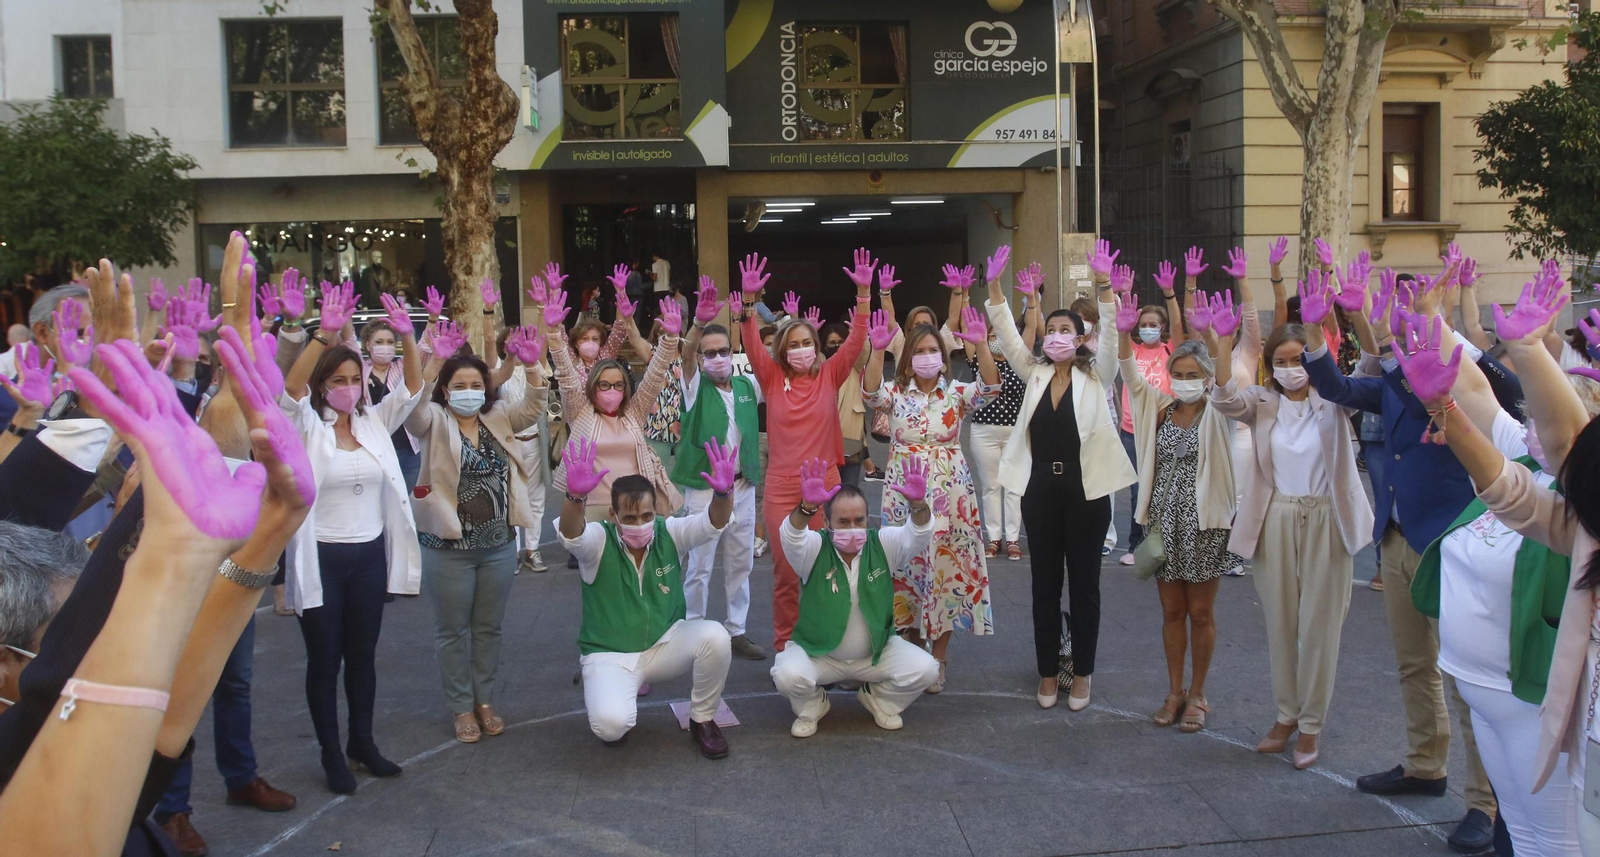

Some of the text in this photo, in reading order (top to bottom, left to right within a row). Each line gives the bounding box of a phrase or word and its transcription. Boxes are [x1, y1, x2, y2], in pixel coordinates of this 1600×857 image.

[933, 56, 1048, 76] garcía espejo
[780, 20, 798, 141] ORTODONCIA
[995, 129, 1063, 140] 957 491 84
[572, 149, 672, 161] invisible autoligado
[770, 152, 909, 164] infantil estética adultos
[256, 232, 374, 253] MANGO
